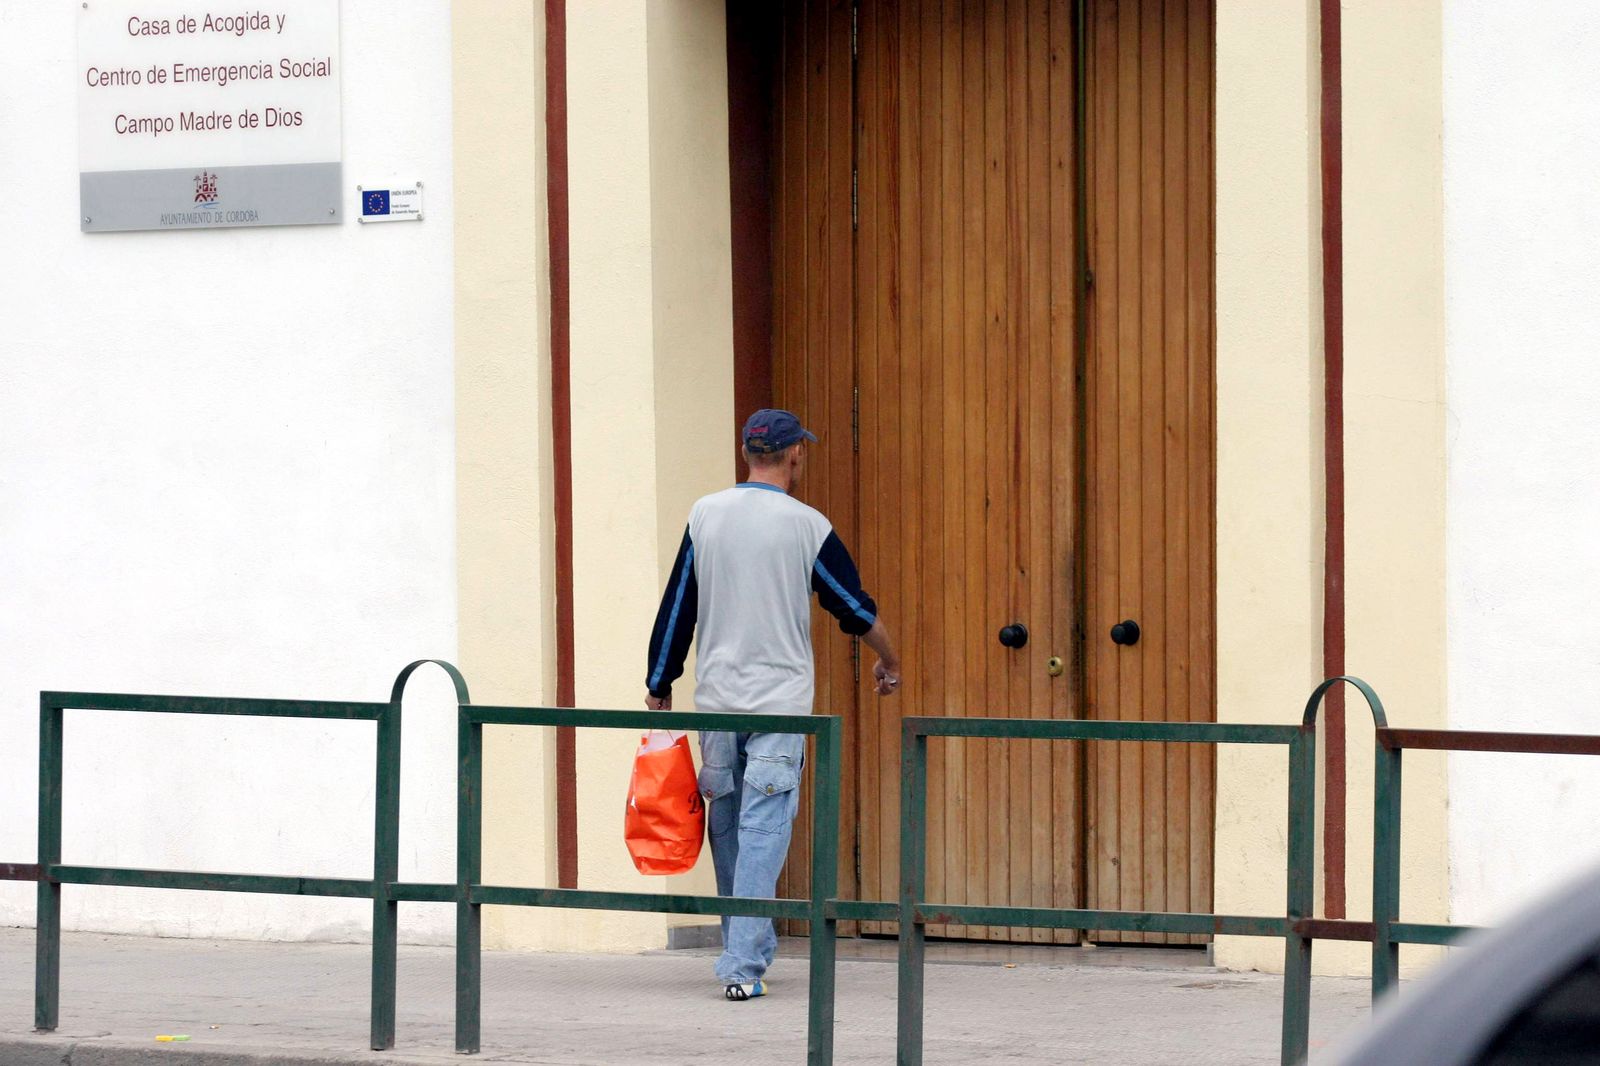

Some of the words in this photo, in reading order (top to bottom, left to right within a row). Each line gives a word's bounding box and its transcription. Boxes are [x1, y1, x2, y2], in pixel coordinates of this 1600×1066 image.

[128, 17, 170, 36] Casa
[177, 15, 196, 34] de
[203, 11, 270, 36] Acogida
[276, 14, 285, 34] y
[87, 67, 141, 87] Centro
[147, 65, 167, 84] de
[174, 60, 273, 86] Emergencia
[280, 57, 330, 78] Social
[115, 114, 174, 137] Campo
[180, 111, 232, 131] Madre
[238, 109, 259, 128] de
[266, 108, 302, 127] Dios
[161, 212, 211, 224] AYUNTAMIENTO
[215, 212, 223, 223] DE
